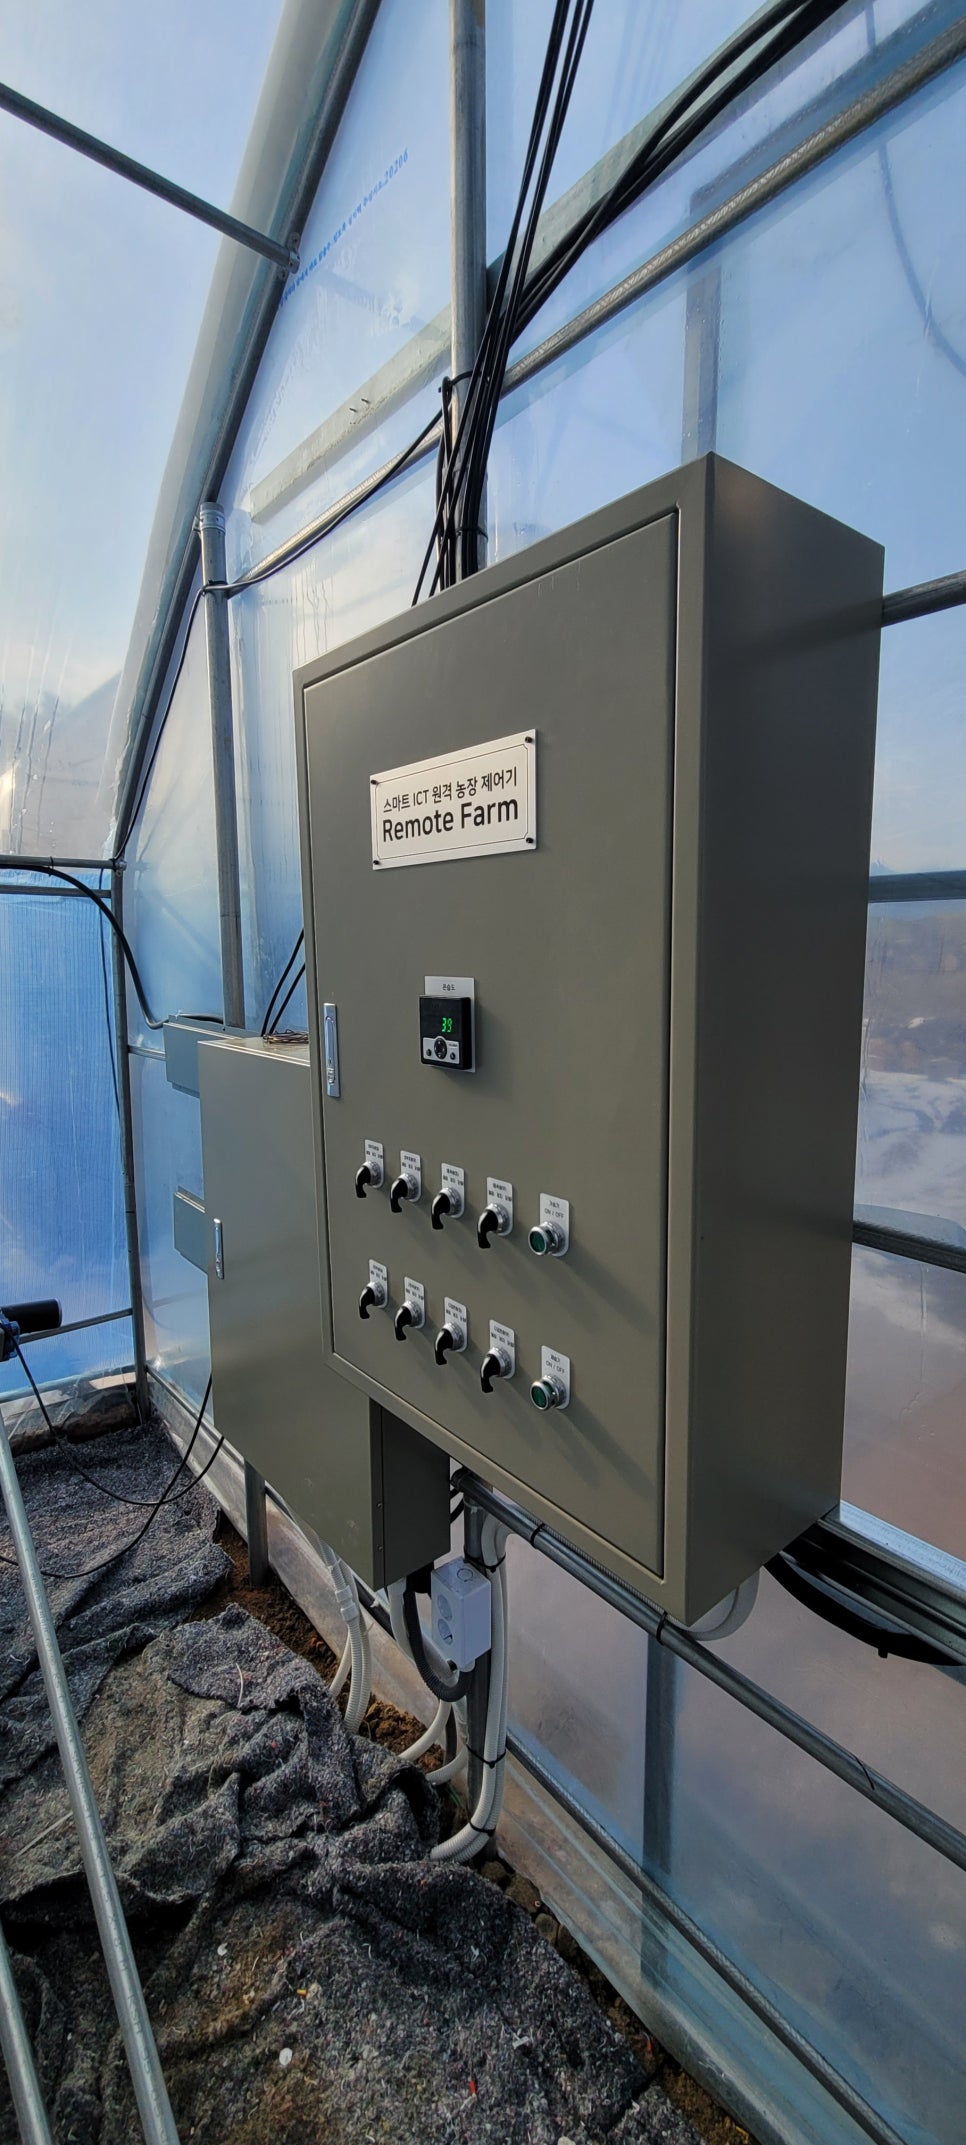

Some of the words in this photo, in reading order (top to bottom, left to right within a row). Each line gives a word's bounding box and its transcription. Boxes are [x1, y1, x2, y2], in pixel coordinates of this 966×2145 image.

[383, 793, 410, 813] 스마트
[413, 789, 430, 807] ICT
[432, 782, 452, 804] 원격
[455, 776, 478, 799] 농장
[481, 766, 517, 792] 제어기
[383, 809, 454, 842] Remote
[461, 798, 518, 829] Farm
[441, 1017, 453, 1033] 39
